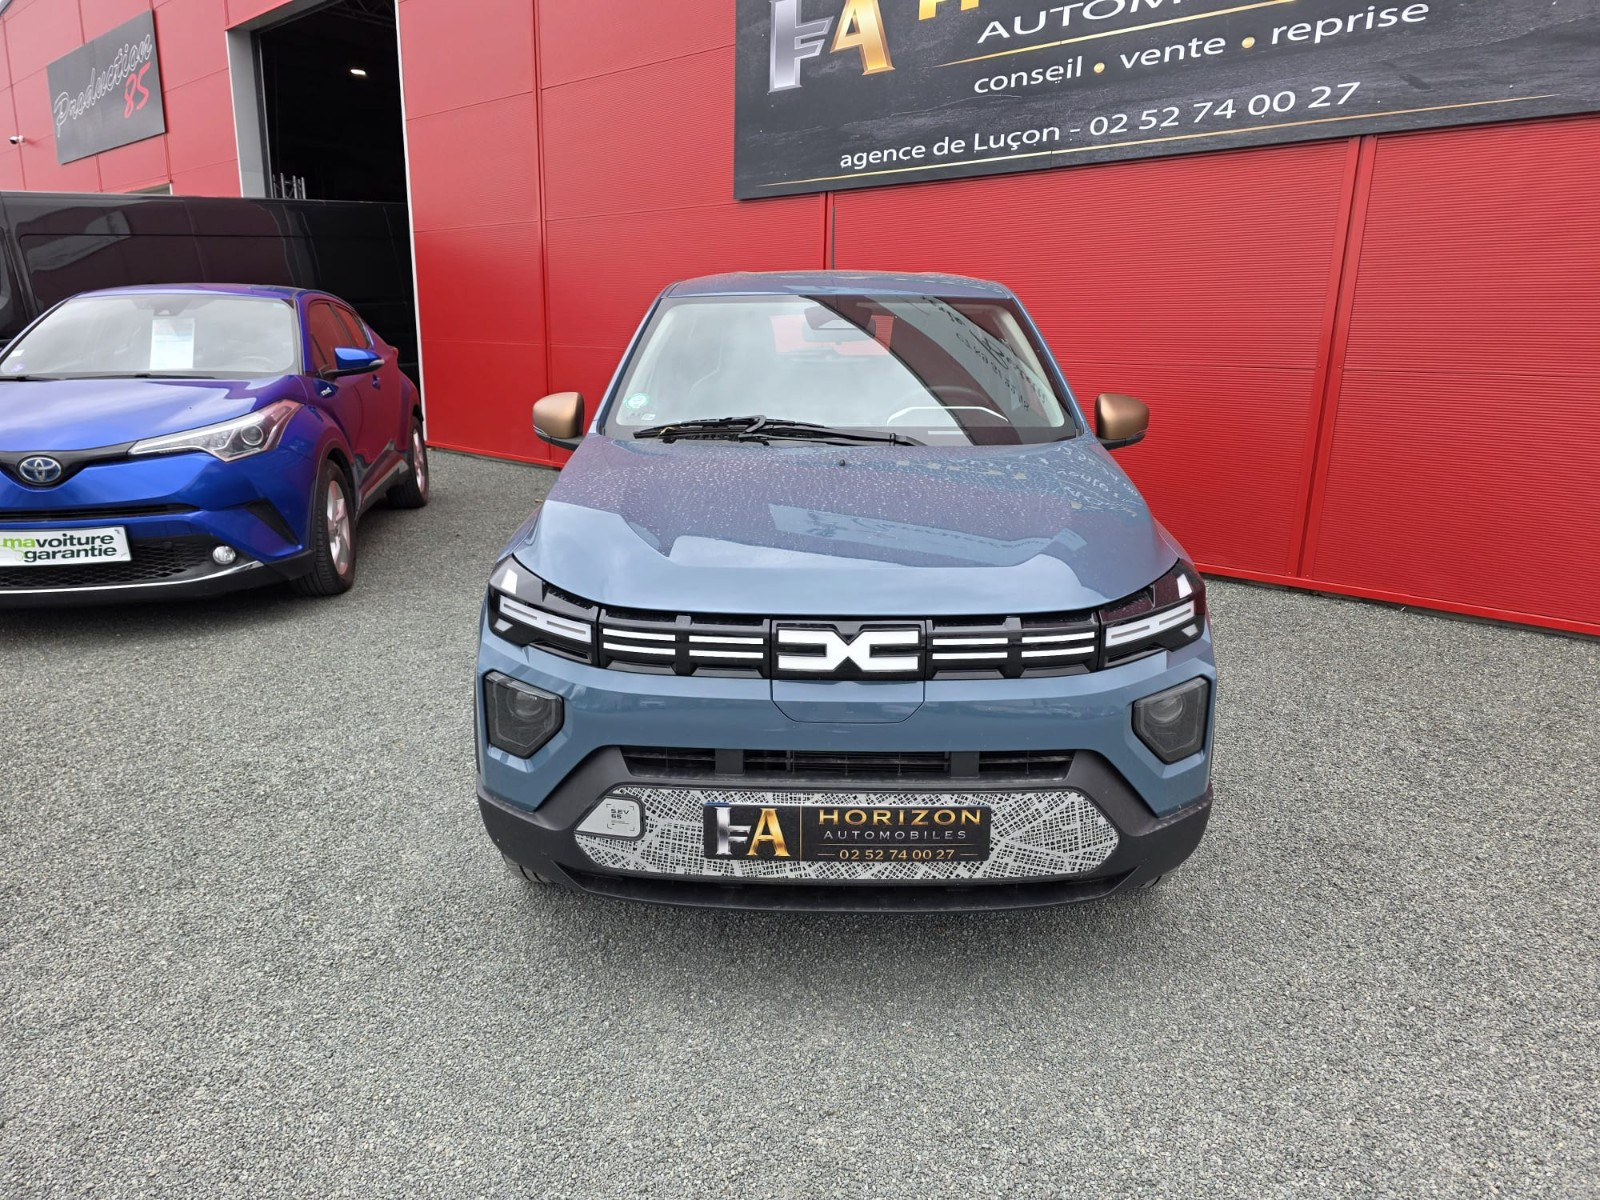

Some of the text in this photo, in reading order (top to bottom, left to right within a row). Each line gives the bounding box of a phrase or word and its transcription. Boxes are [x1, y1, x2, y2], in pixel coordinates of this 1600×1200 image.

[974, 3, 1429, 94] conseil vente reprise
[123, 62, 151, 119] 85
[840, 145, 926, 170] agence
[932, 136, 966, 156] de
[974, 126, 1060, 151] Luçon
[1089, 113, 1128, 136] 02
[1138, 106, 1180, 131] 52
[1193, 98, 1237, 123] 74
[1247, 90, 1296, 116] 00
[1307, 81, 1361, 109] 27
[24, 545, 117, 563] garantie
[818, 809, 981, 826] HORIZON
[823, 830, 967, 840] AUTOMOBILES
[839, 849, 955, 860] 02 52 74 00 27
